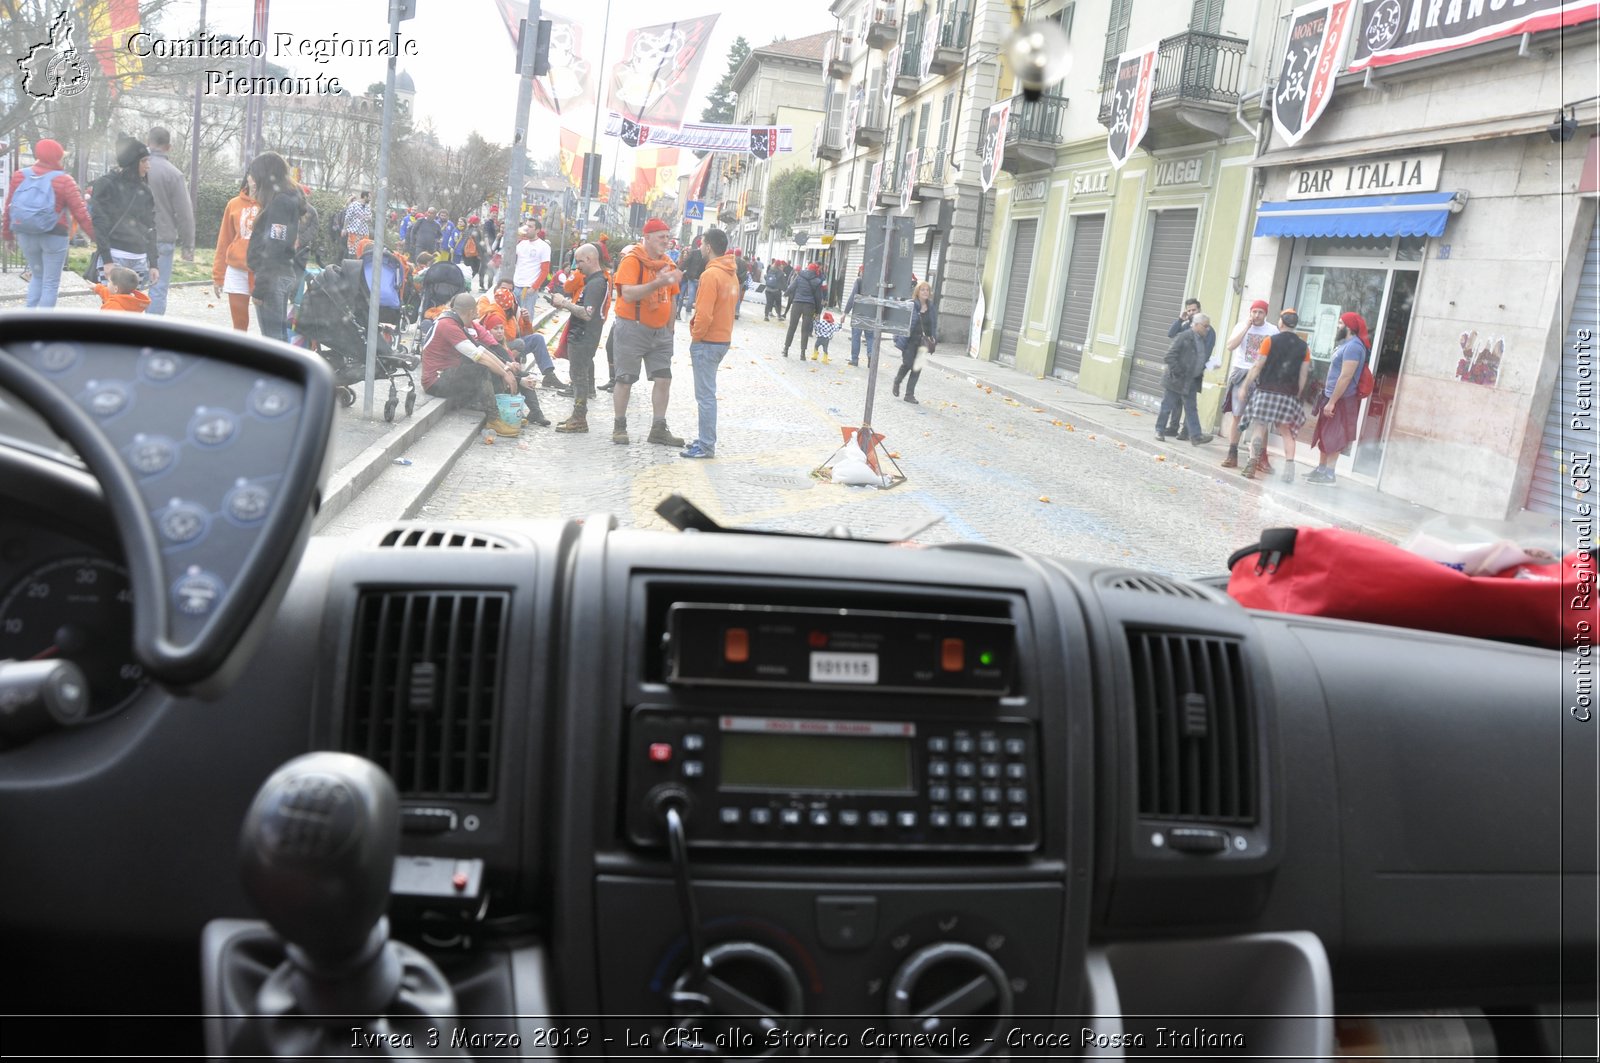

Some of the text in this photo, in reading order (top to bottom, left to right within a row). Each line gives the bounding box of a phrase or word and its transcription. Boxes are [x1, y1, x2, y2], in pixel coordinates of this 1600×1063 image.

[1292, 17, 1325, 40] MORTE
[1153, 158, 1202, 186] VIAGGI
[1298, 160, 1423, 194] BAR ITALIA
[76, 568, 98, 584] 30
[27, 582, 50, 598] 20
[5, 618, 23, 634] 10
